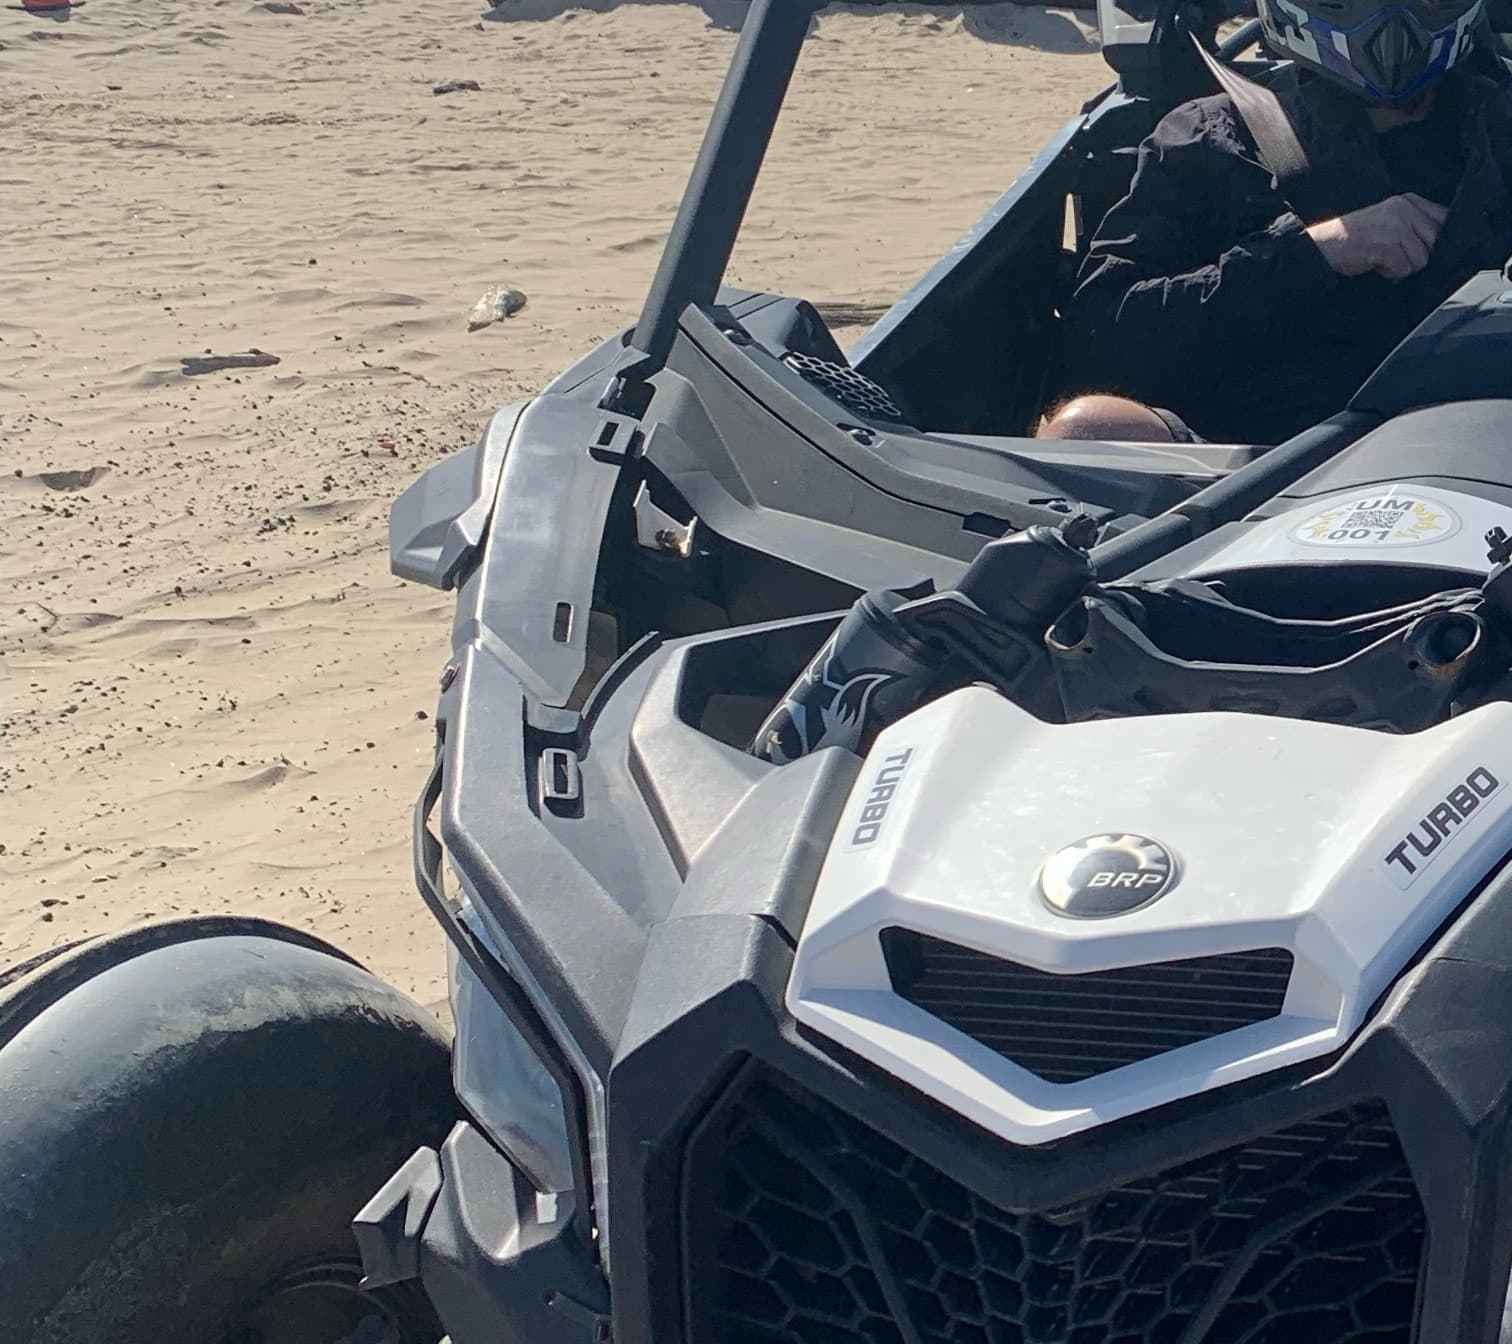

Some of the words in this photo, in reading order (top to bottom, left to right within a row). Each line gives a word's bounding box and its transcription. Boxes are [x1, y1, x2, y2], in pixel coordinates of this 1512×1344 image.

[1356, 499, 1414, 511] UM
[1328, 529, 1391, 540] 001
[852, 747, 914, 846] TURBO
[1384, 766, 1500, 875] TURBO
[1087, 871, 1165, 889] BRP
